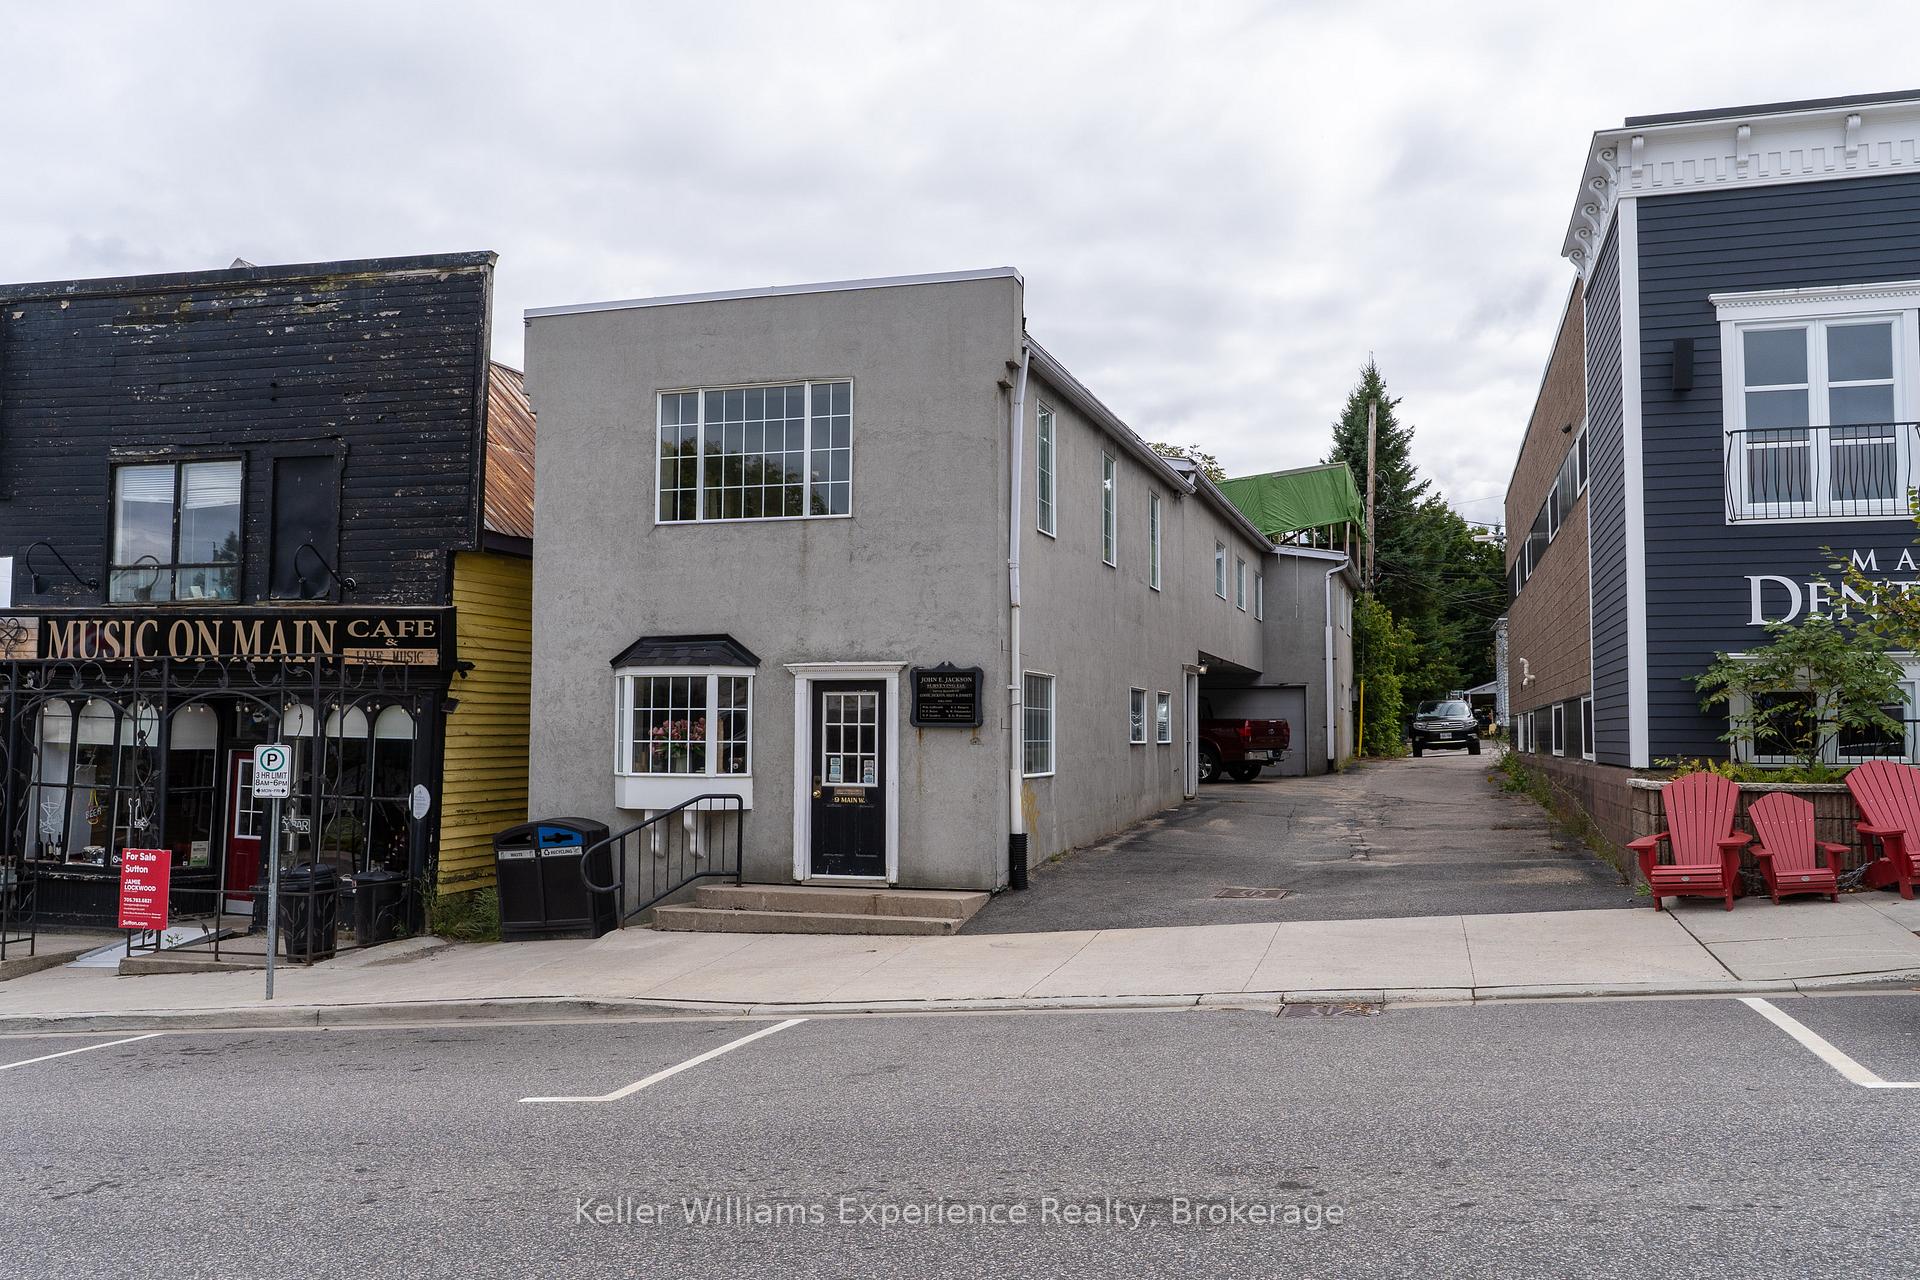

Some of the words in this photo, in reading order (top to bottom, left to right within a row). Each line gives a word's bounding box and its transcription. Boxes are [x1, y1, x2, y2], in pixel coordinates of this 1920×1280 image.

[347, 620, 436, 638] CAFE
[46, 619, 158, 662] MUSIC
[168, 619, 221, 663] ON
[230, 619, 337, 664] MAIN
[385, 638, 398, 646] &
[356, 650, 383, 663] LIVE
[392, 650, 424, 664] MUSIC
[267, 753, 278, 766] P
[126, 852, 139, 861] For
[140, 852, 157, 861] Sale
[125, 864, 149, 873] Sutton
[122, 919, 148, 927] Sutton.com
